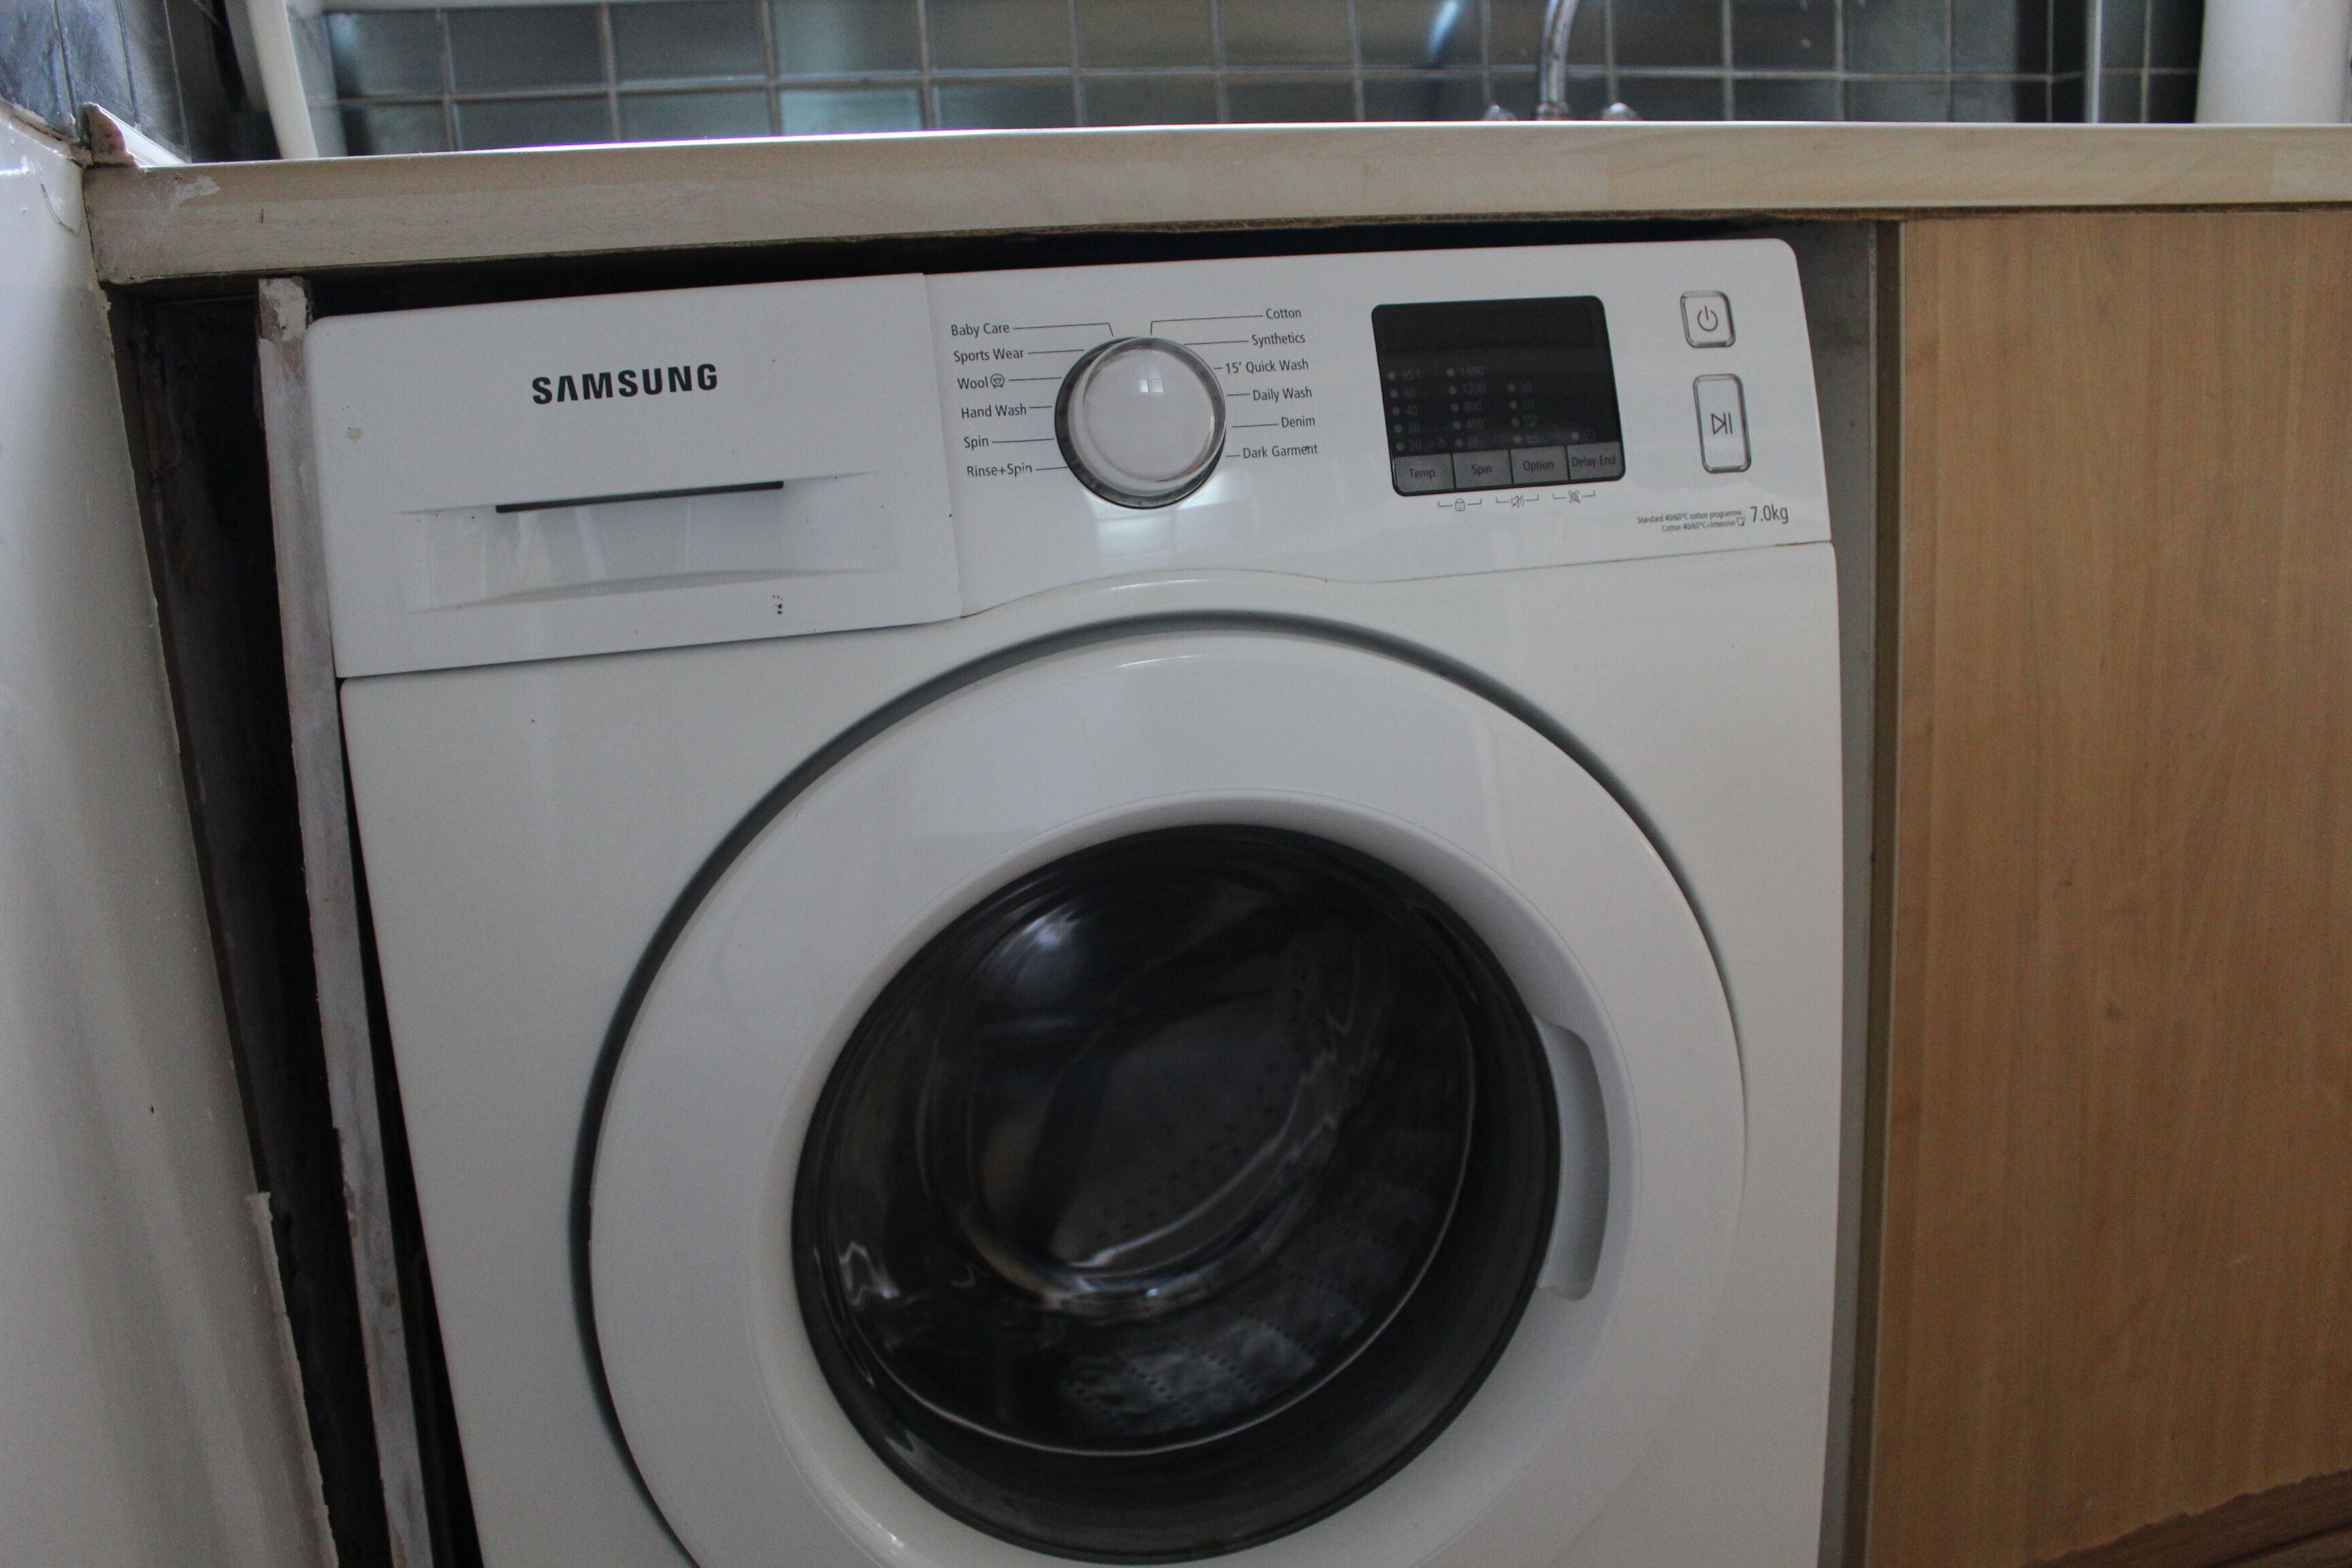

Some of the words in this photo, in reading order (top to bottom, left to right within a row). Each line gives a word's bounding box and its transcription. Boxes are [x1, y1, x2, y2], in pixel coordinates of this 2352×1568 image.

[1266, 308, 1302, 319] Cotton
[951, 324, 979, 338] Baby
[983, 323, 1009, 334] Care
[1252, 332, 1305, 348] Synthetics
[954, 350, 990, 364] Sports
[993, 348, 1024, 360] Wear
[1246, 360, 1276, 374] Quick
[1279, 358, 1309, 371] Wash
[532, 363, 717, 404] SAMSUNG
[958, 376, 988, 389] Wool
[1253, 389, 1279, 403] Daily
[1283, 386, 1312, 399] Wash
[962, 404, 992, 419] Hand
[996, 403, 1026, 416] Wash
[1281, 416, 1316, 428] Denim
[964, 436, 989, 450] Spin
[1243, 446, 1268, 459] Dark
[1272, 444, 1318, 457] Garment
[1523, 460, 1554, 472] Option
[1572, 457, 1597, 469] Delay
[1600, 455, 1616, 466] End
[967, 463, 1032, 477] Rinse+Spin
[1472, 465, 1492, 476] Spin
[1637, 512, 1664, 524] Standard
[1690, 511, 1708, 520] cotton
[1750, 504, 1788, 524] 7.0kg
[1662, 524, 1682, 532] Cotton
